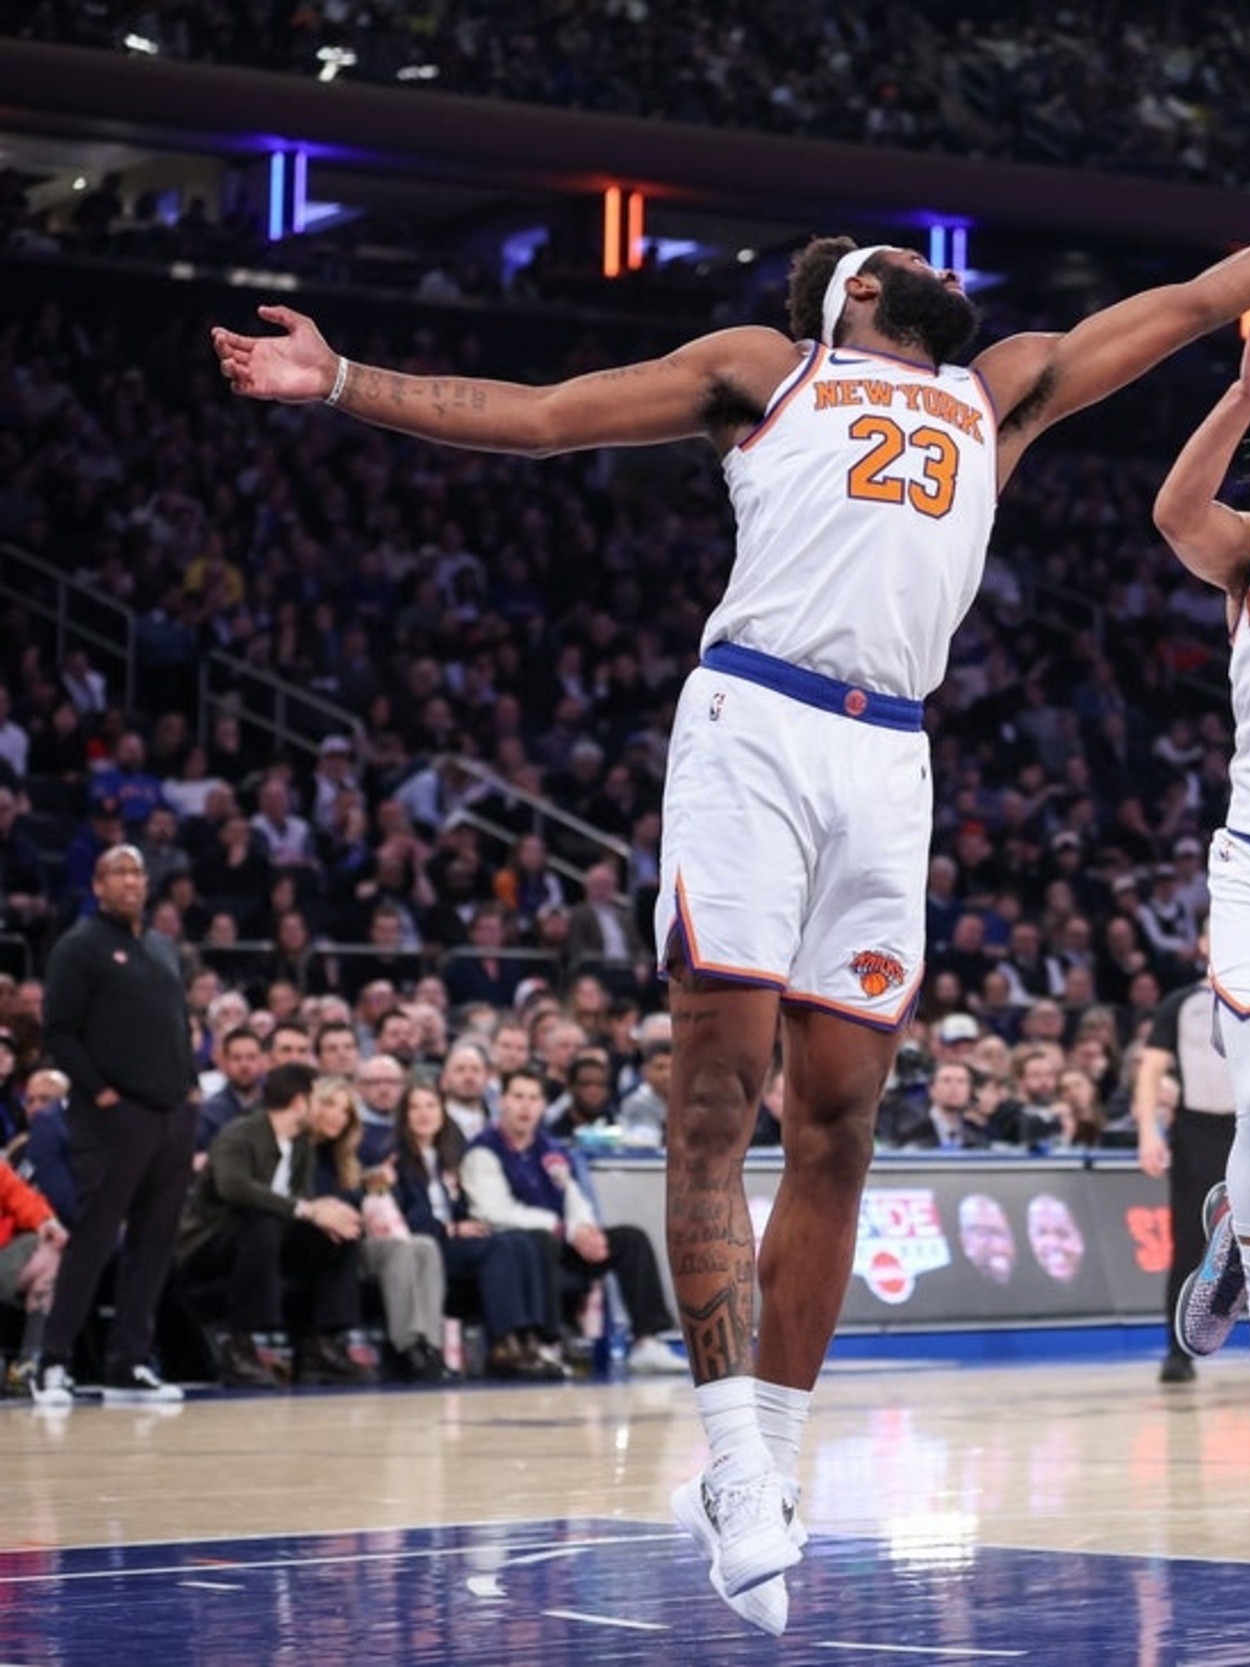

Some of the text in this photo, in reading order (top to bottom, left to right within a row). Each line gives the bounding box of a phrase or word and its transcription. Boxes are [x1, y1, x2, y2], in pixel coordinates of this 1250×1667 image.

[814, 379, 985, 445] NEW YORK
[847, 413, 960, 519] 23
